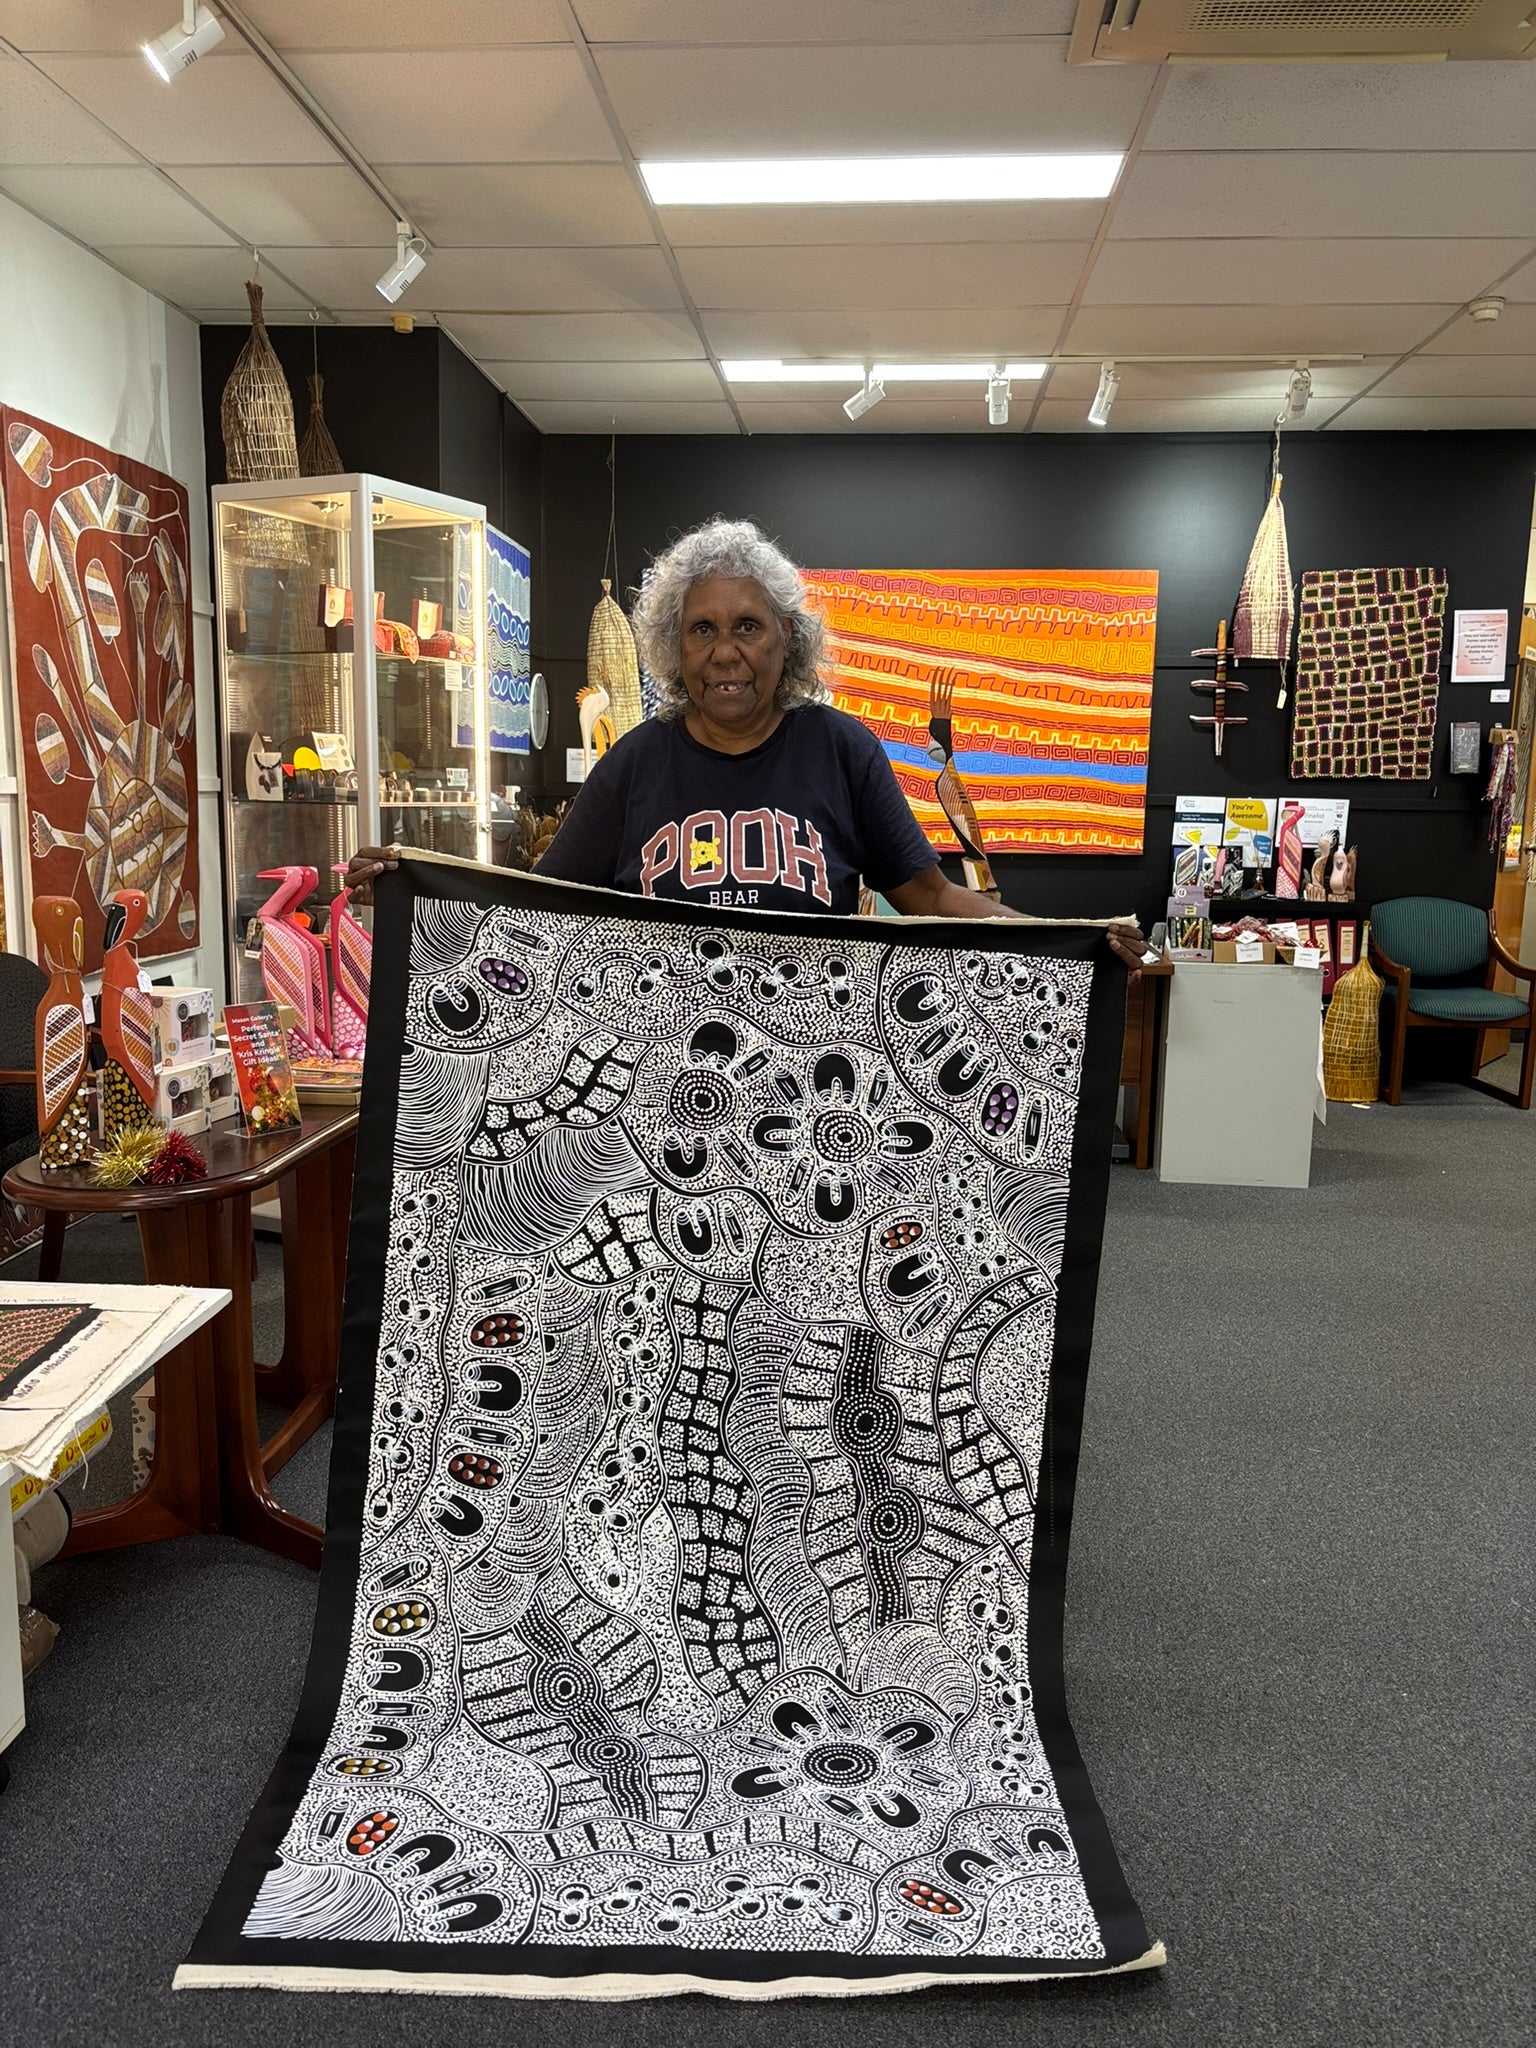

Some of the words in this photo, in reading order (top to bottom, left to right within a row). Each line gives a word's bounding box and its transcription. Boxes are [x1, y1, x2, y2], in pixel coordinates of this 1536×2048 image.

[640, 807, 832, 907] POOH
[709, 889, 759, 906] BEAR
[241, 1024, 267, 1032] Perfect
